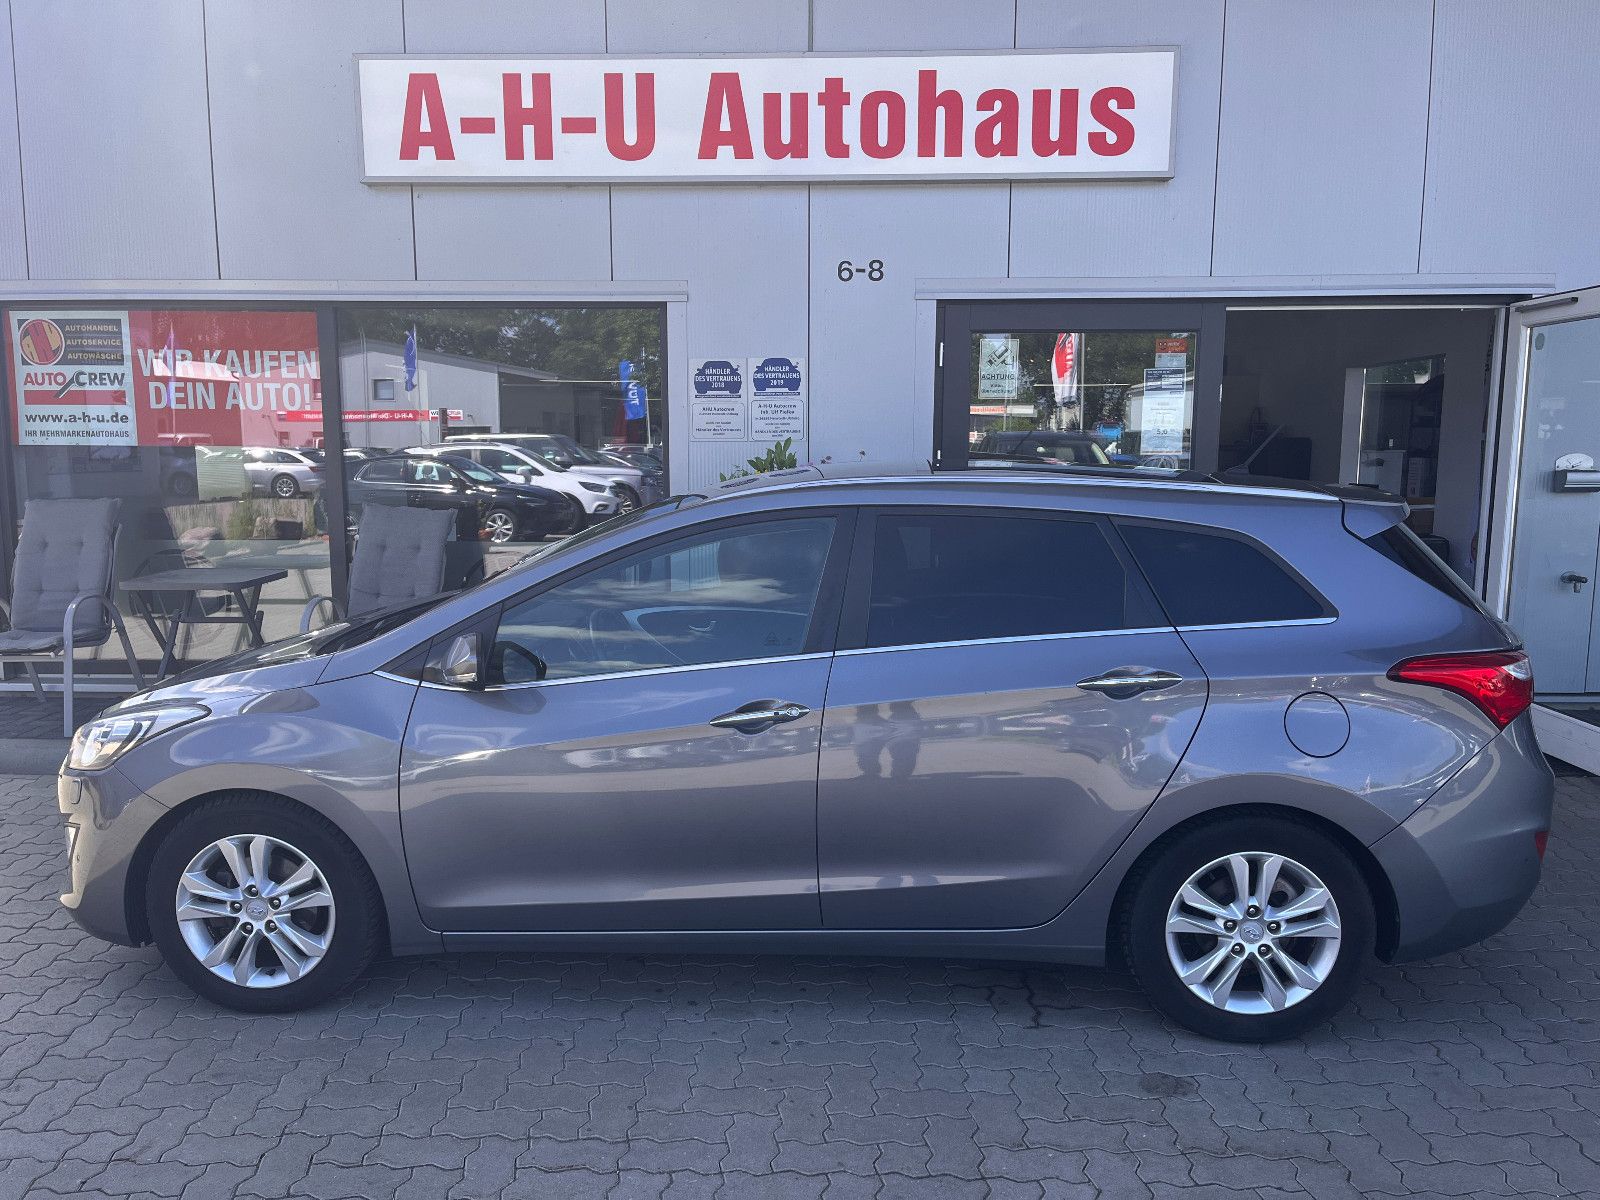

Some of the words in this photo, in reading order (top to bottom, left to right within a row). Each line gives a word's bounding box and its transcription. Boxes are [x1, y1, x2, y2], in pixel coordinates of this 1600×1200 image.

[399, 73, 655, 161] A-H-U
[697, 70, 1136, 160] Autohaus
[837, 259, 884, 282] 6-8
[65, 324, 118, 332] AUTOHANDEL
[66, 338, 122, 346] AUTOSERVICE
[137, 348, 194, 377] WIR
[203, 349, 320, 379] KAUFEN
[705, 367, 731, 375] HÄNDLER
[23, 371, 67, 387] AUTO
[74, 371, 126, 387] CREW
[149, 381, 216, 410] DEIN
[225, 382, 311, 411] AUTO!
[25, 411, 129, 424] www.a-h-u.de
[25, 430, 38, 438] IHR
[39, 430, 130, 438] MEHRMARKENAUTOHAUS
